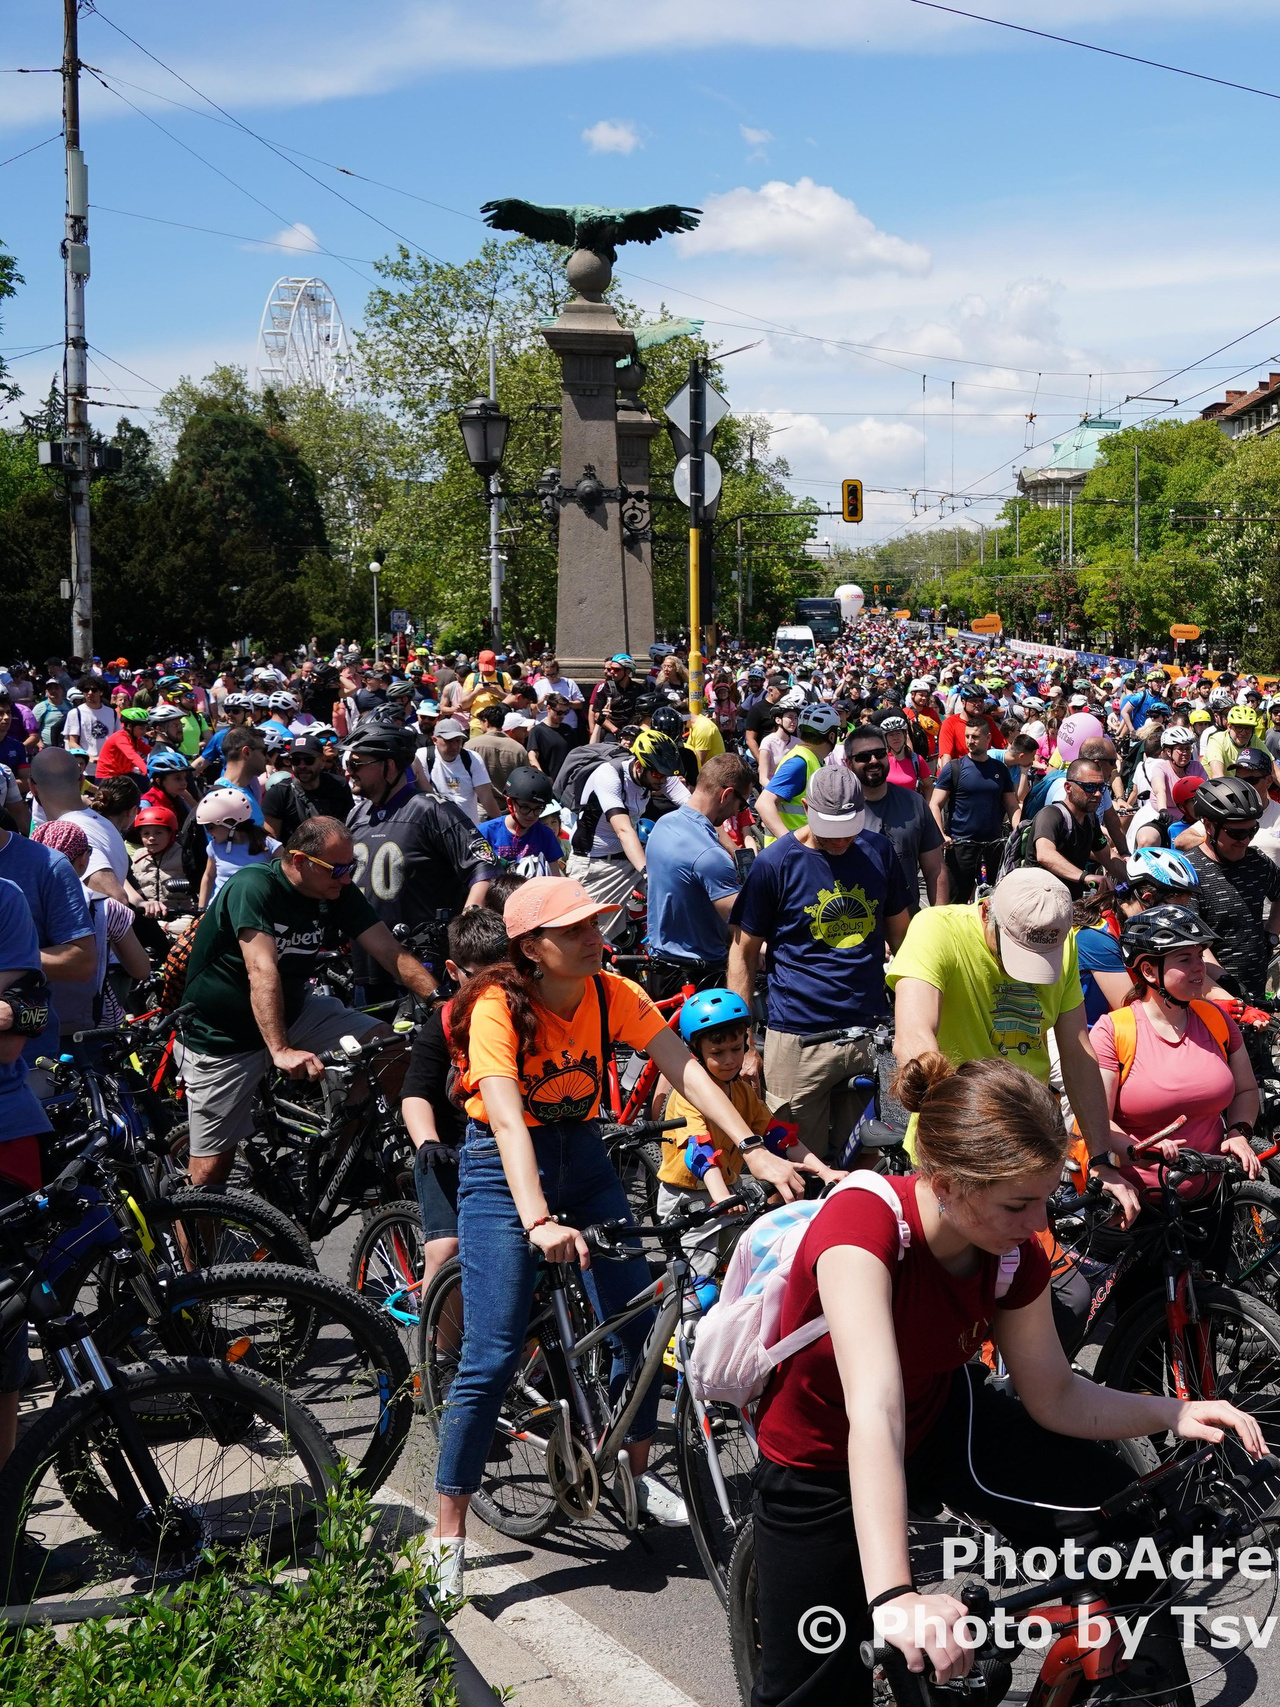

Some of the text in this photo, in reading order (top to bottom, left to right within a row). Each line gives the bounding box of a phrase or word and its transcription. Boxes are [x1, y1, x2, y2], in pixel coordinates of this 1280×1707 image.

[352, 841, 405, 901] 20
[1027, 931, 1058, 945] Wolfskin
[326, 1135, 362, 1200] CROSSWIND
[209, 1206, 254, 1222] GALAXY
